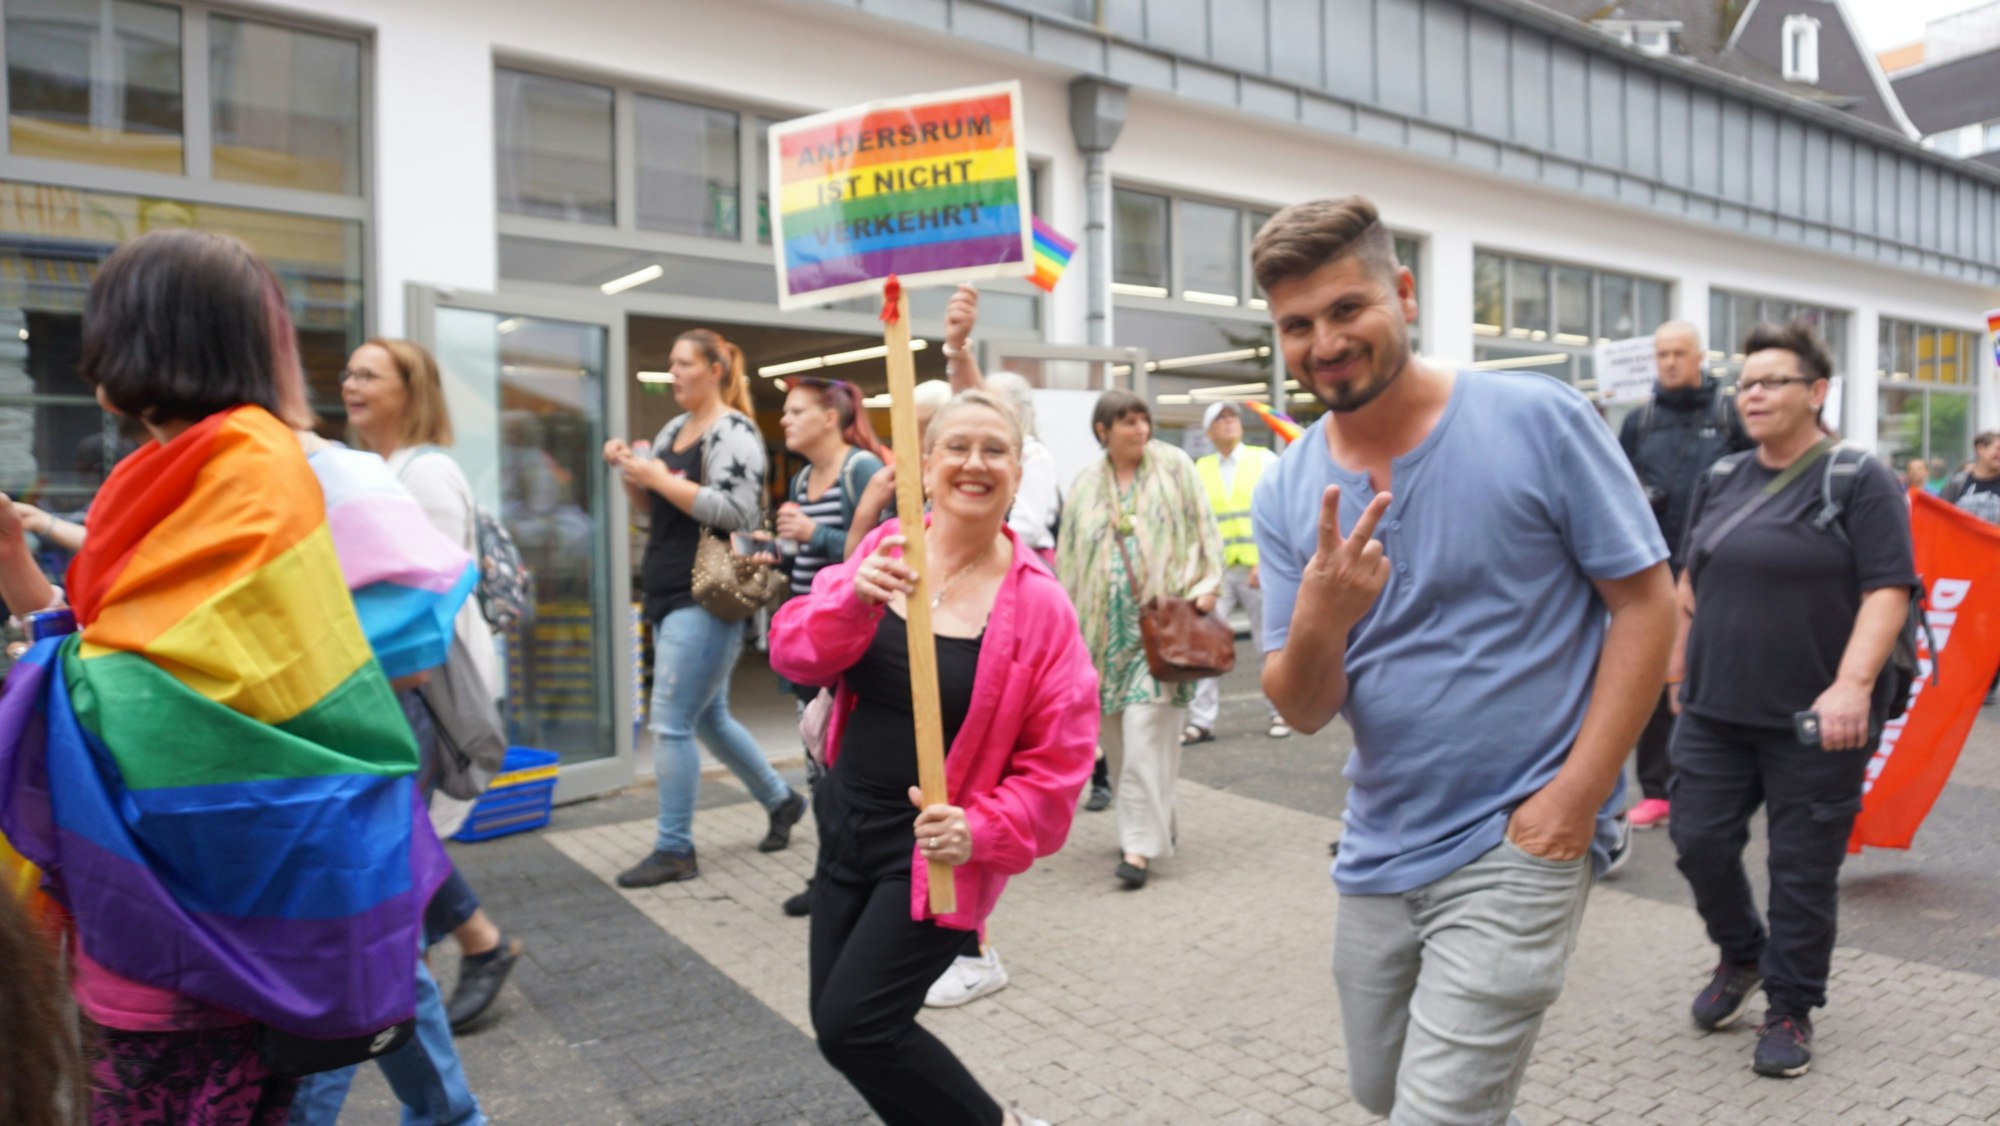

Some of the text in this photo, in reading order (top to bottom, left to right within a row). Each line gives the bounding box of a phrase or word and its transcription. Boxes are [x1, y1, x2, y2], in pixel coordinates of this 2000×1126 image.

[798, 114, 992, 167] ANDERSRUM
[816, 159, 974, 205] IST NICHT
[812, 201, 983, 247] VERKEHRT
